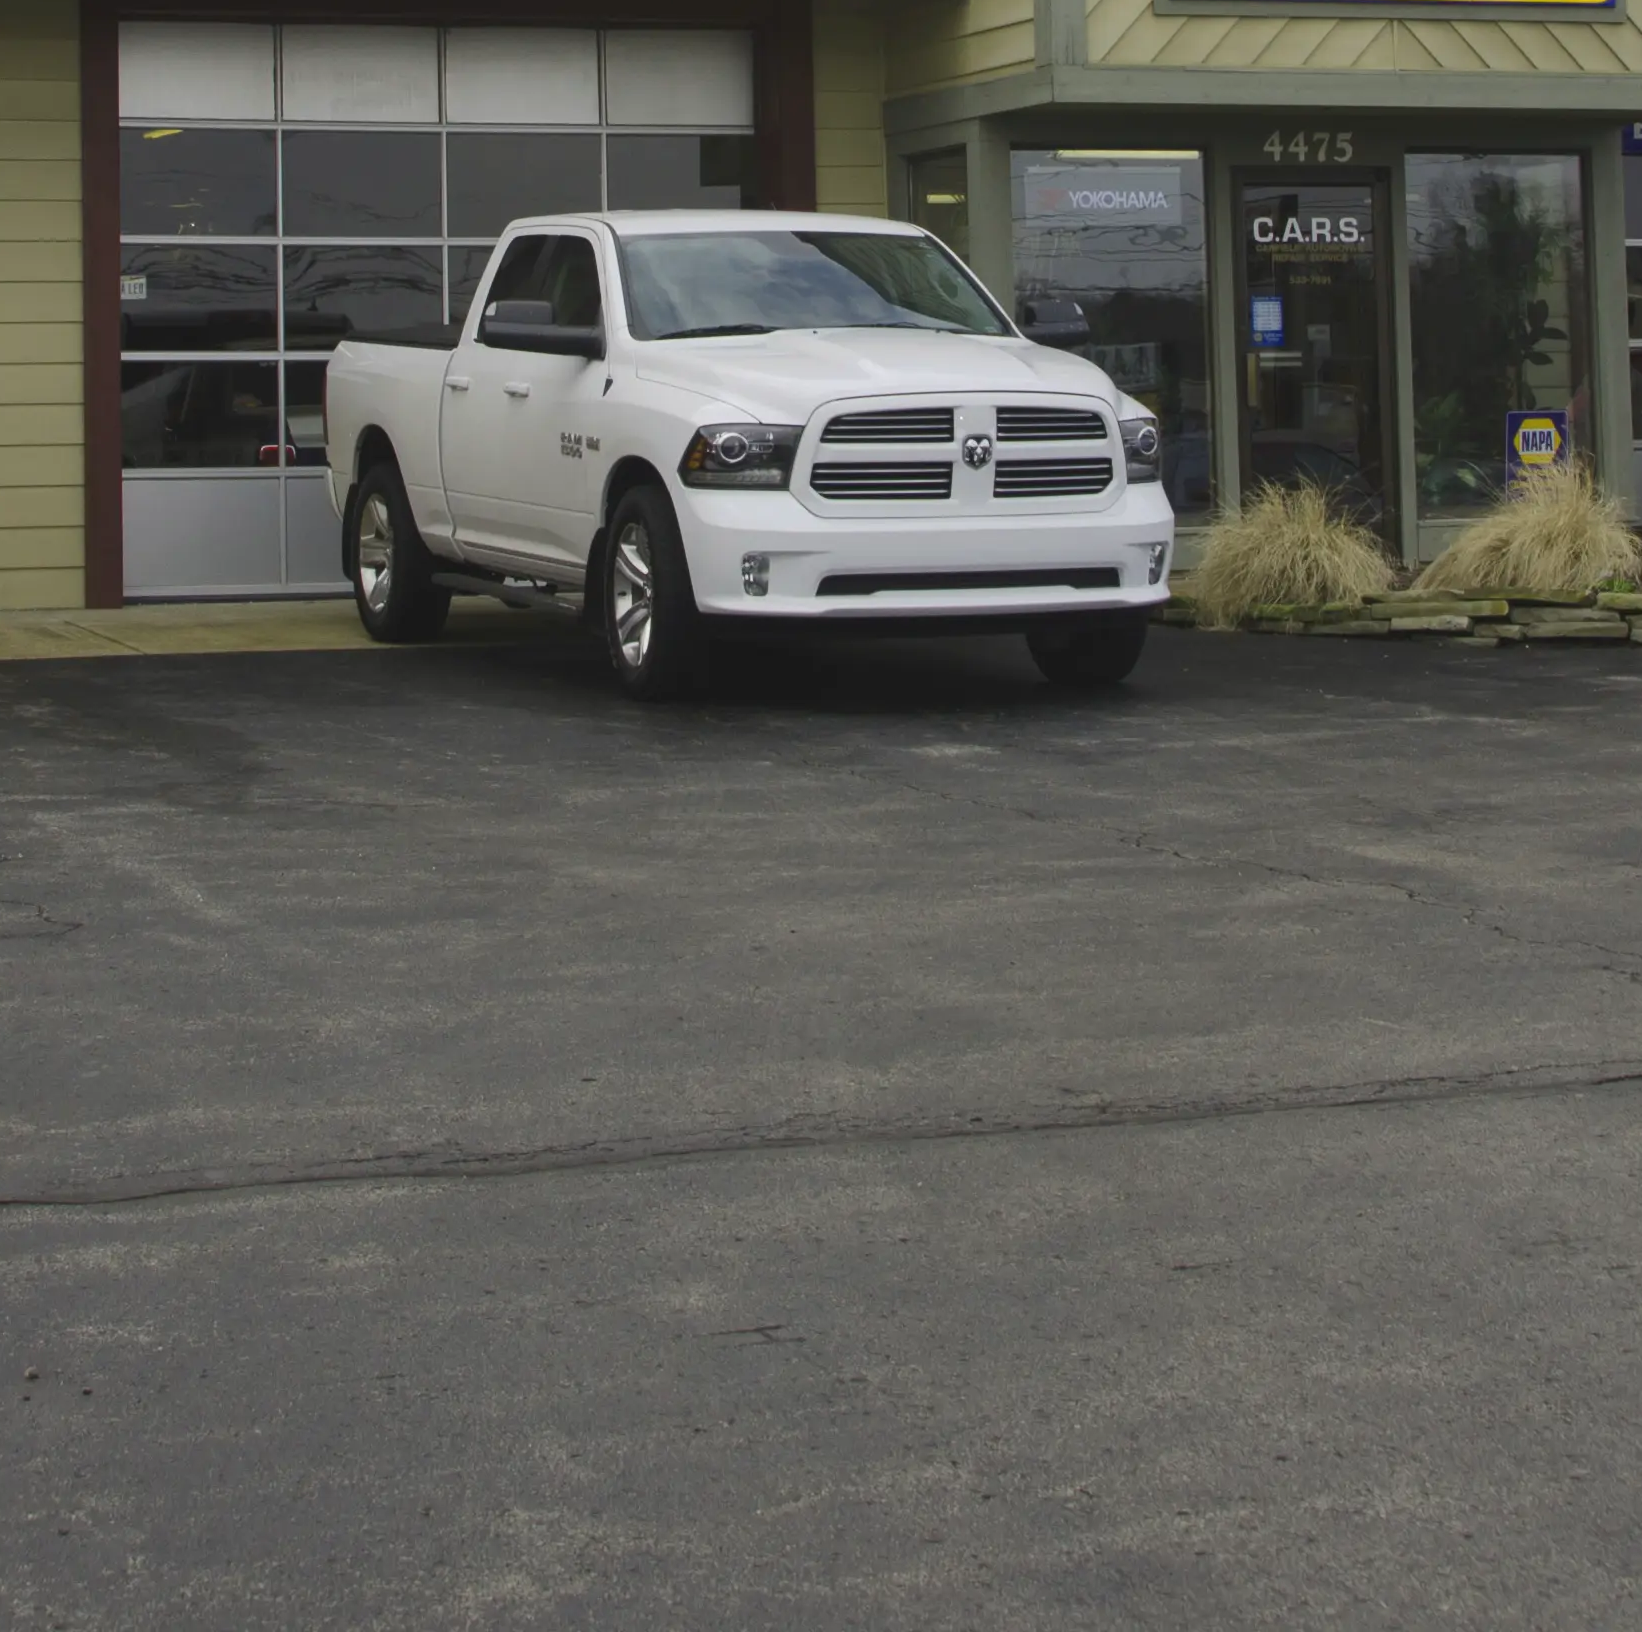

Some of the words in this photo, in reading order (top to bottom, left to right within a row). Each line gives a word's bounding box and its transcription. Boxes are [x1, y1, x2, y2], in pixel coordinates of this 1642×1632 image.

[1263, 130, 1354, 163] 4475
[1068, 190, 1169, 209] YOKOHAMA
[1253, 216, 1366, 243] C.A.R.S.
[1521, 431, 1553, 452] NAPA
